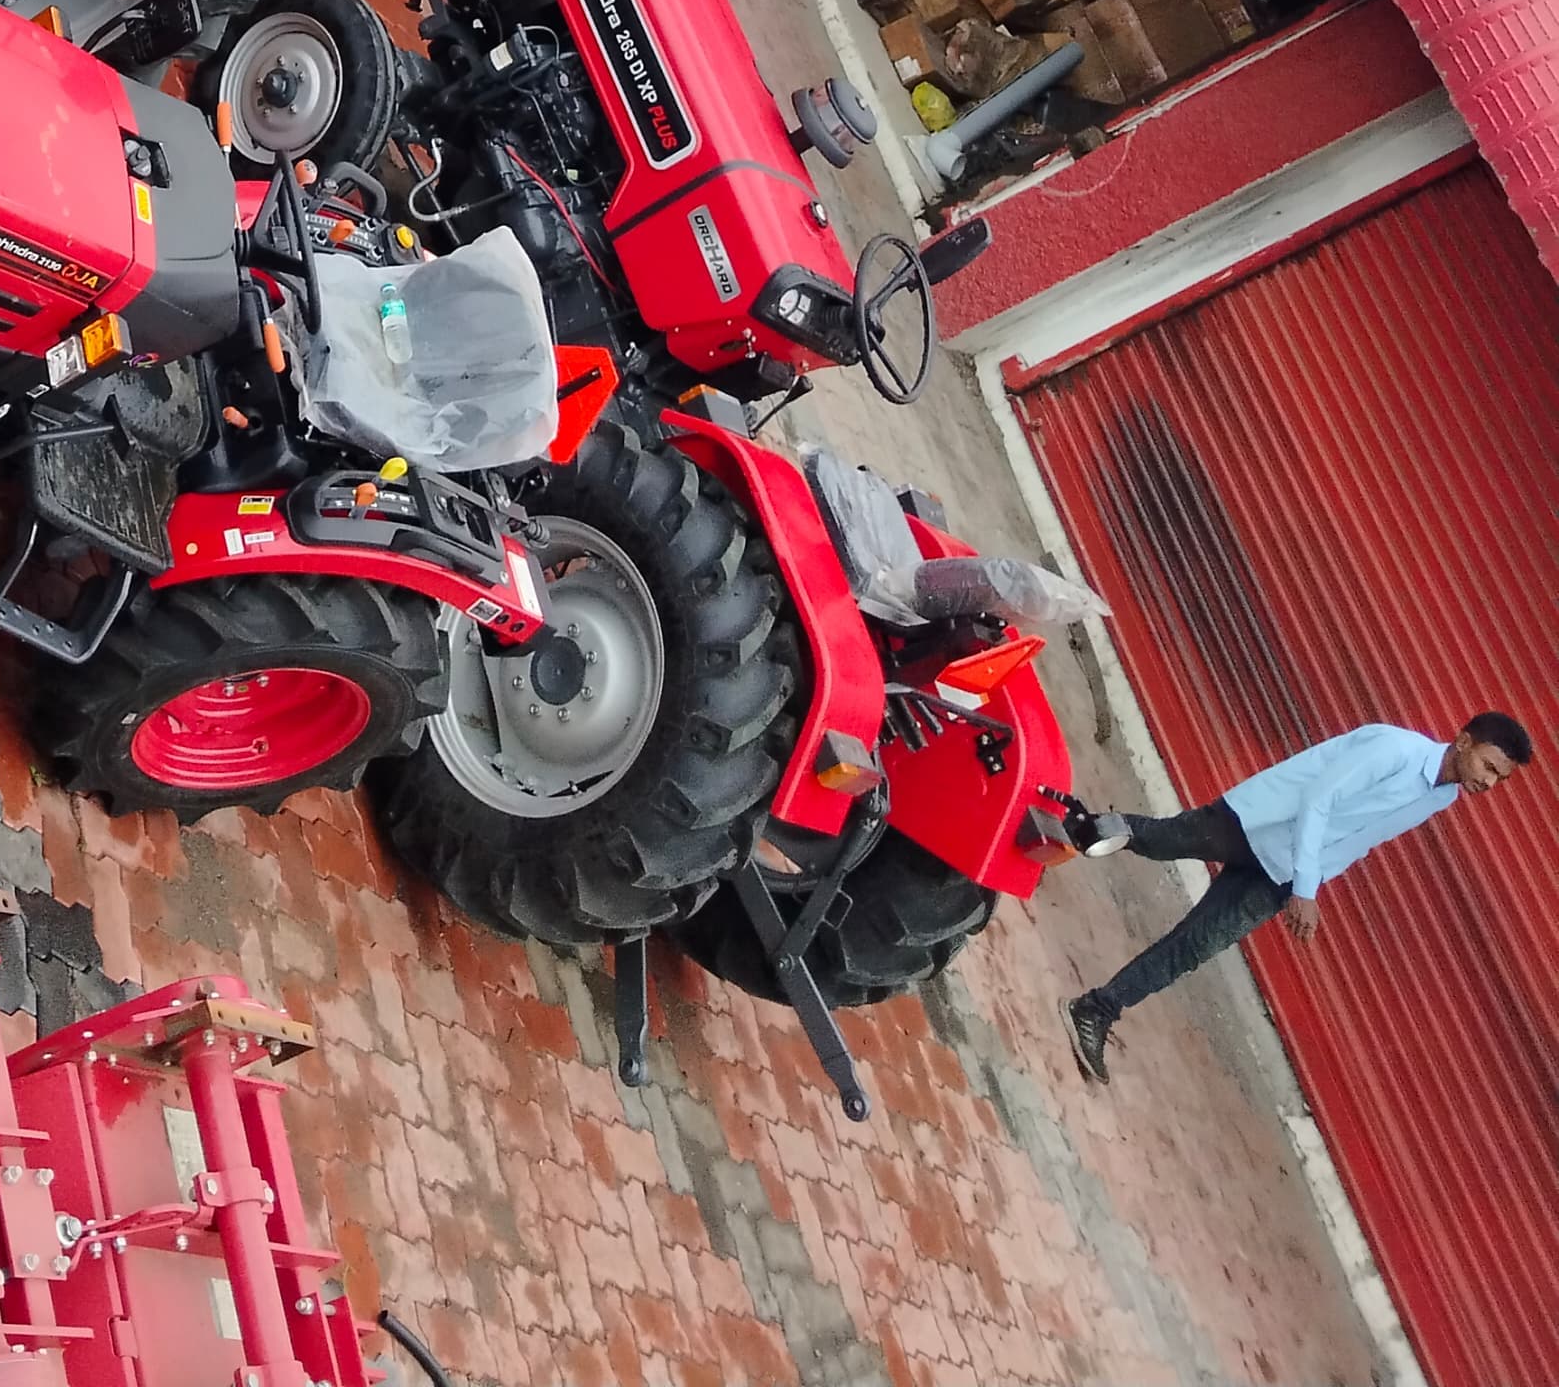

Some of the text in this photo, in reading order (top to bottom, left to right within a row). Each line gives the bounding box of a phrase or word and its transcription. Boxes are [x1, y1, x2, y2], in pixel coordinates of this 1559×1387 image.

[615, 29, 638, 60] 265
[629, 59, 648, 80] DI
[637, 78, 659, 105] XP
[647, 105, 677, 151] PLUS
[694, 214, 733, 296] ORCHARD
[61, 263, 100, 289] OJA
